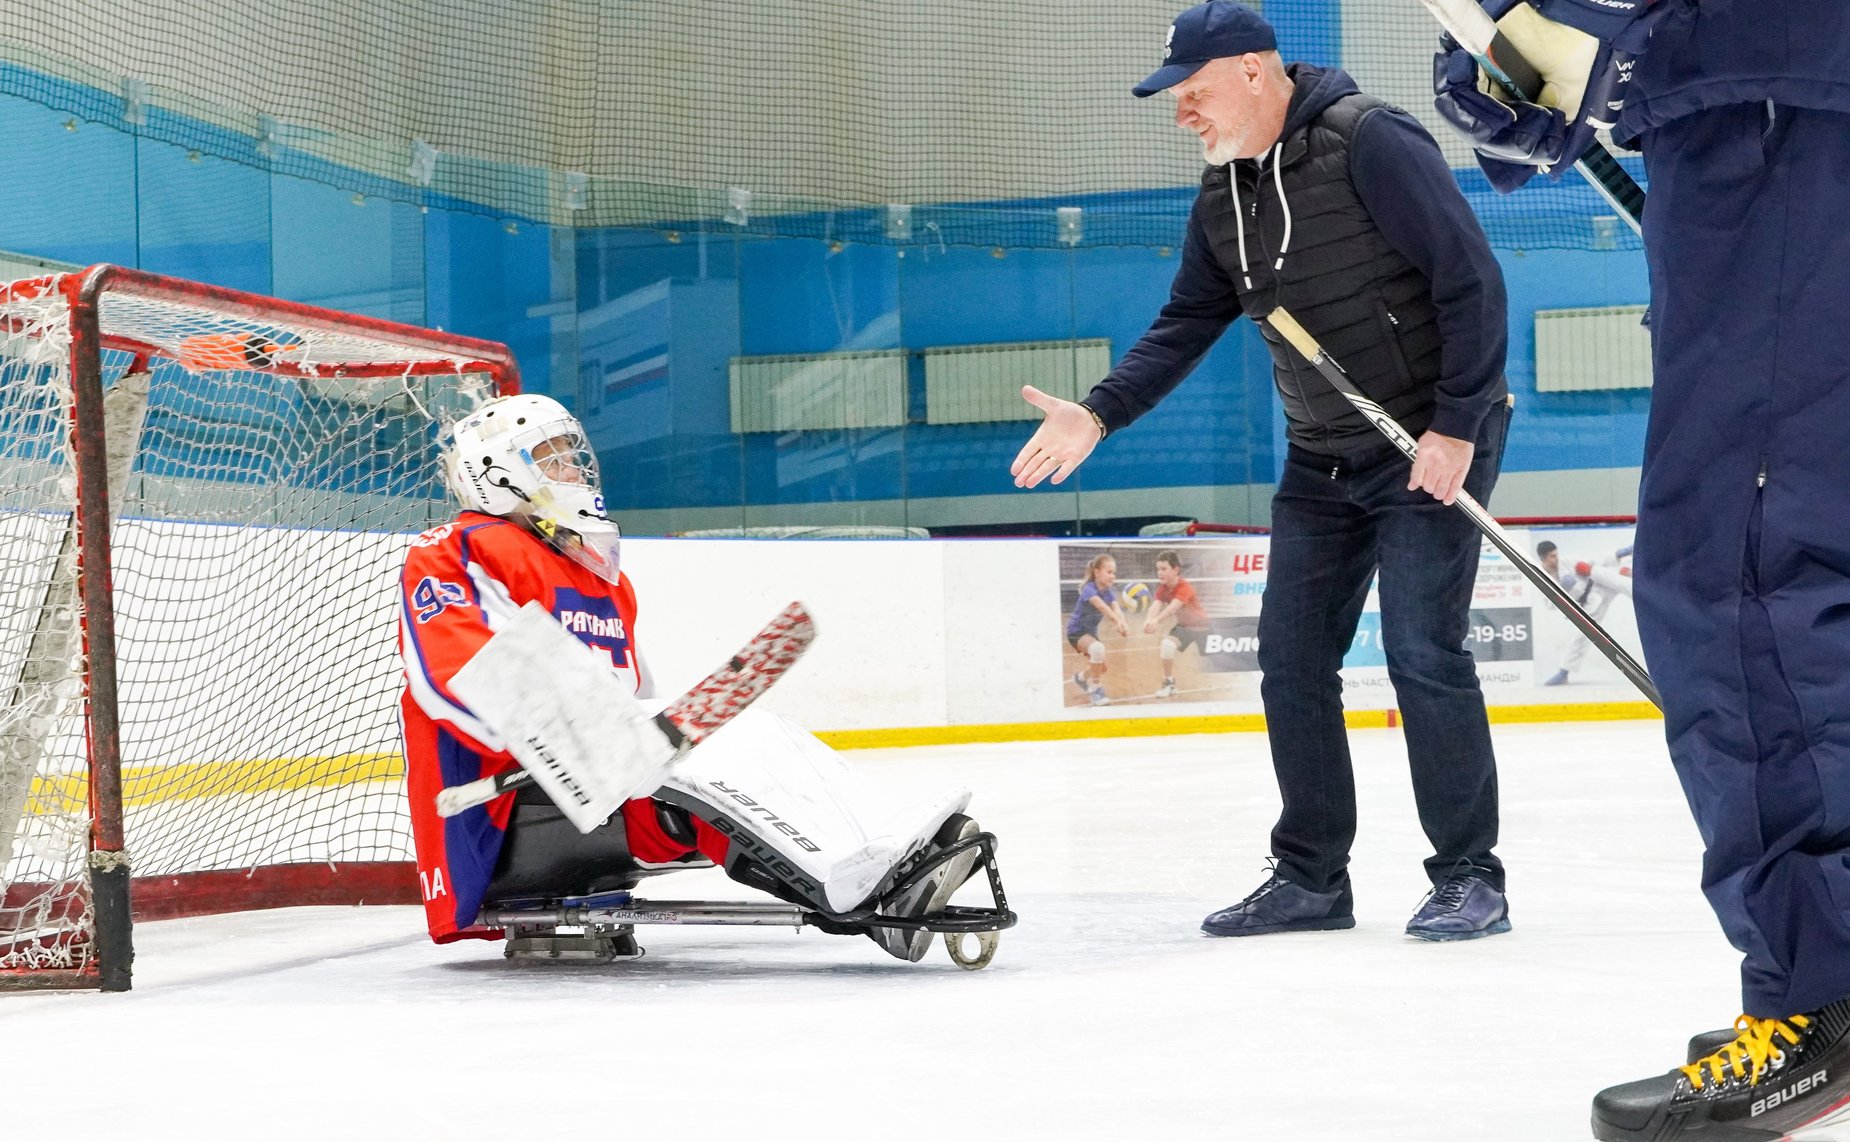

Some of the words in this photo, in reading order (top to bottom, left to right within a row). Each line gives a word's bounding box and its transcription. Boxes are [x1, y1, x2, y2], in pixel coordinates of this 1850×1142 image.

[1233, 554, 1270, 574] ЦЕ
[1233, 582, 1267, 595] ВНЕ
[1361, 677, 1390, 687] ЧАСТ
[710, 816, 817, 895] BAUER
[1750, 1069, 1828, 1118] BAUER
